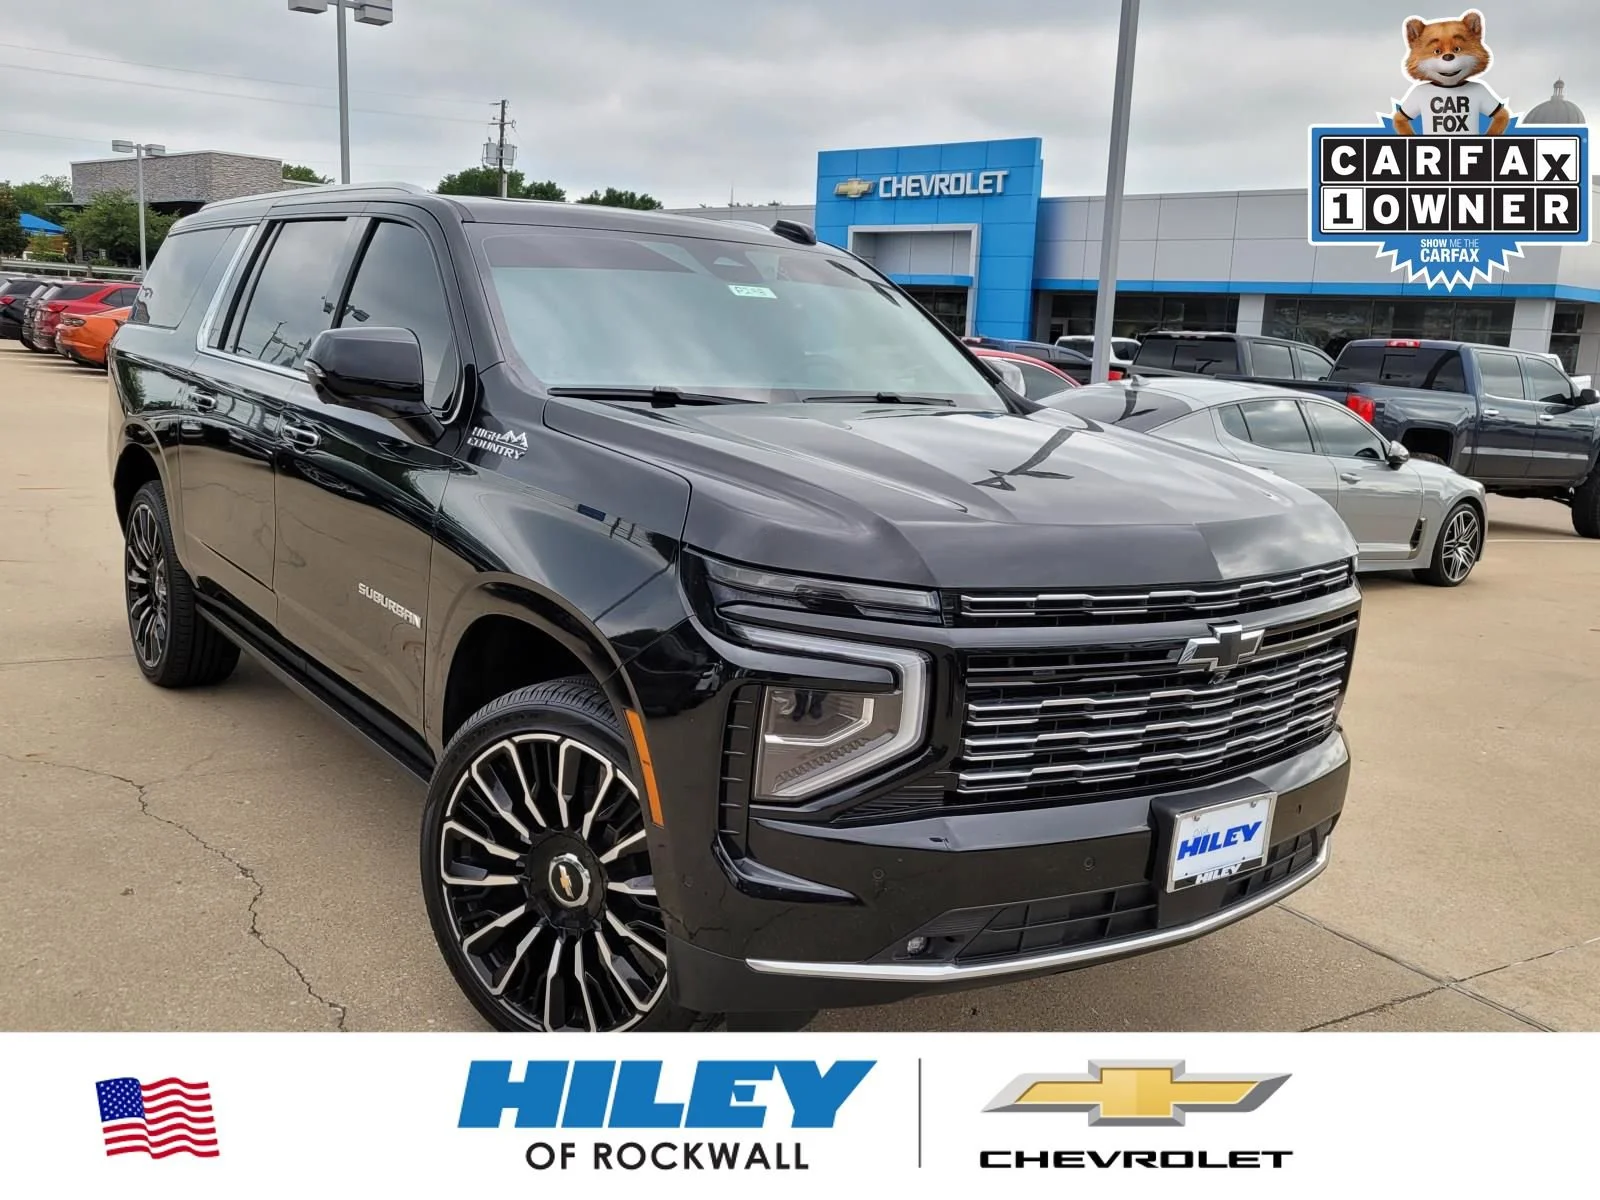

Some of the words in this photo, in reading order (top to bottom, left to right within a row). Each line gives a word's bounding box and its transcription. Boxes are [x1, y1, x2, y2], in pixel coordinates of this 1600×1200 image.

[879, 171, 1008, 197] CHEVROLET
[471, 426, 501, 441] HIGH
[467, 437, 525, 459] COUNTRY
[358, 582, 421, 629] SUBURBAN
[1177, 821, 1262, 860] HILEY
[1194, 863, 1242, 885] HILEY
